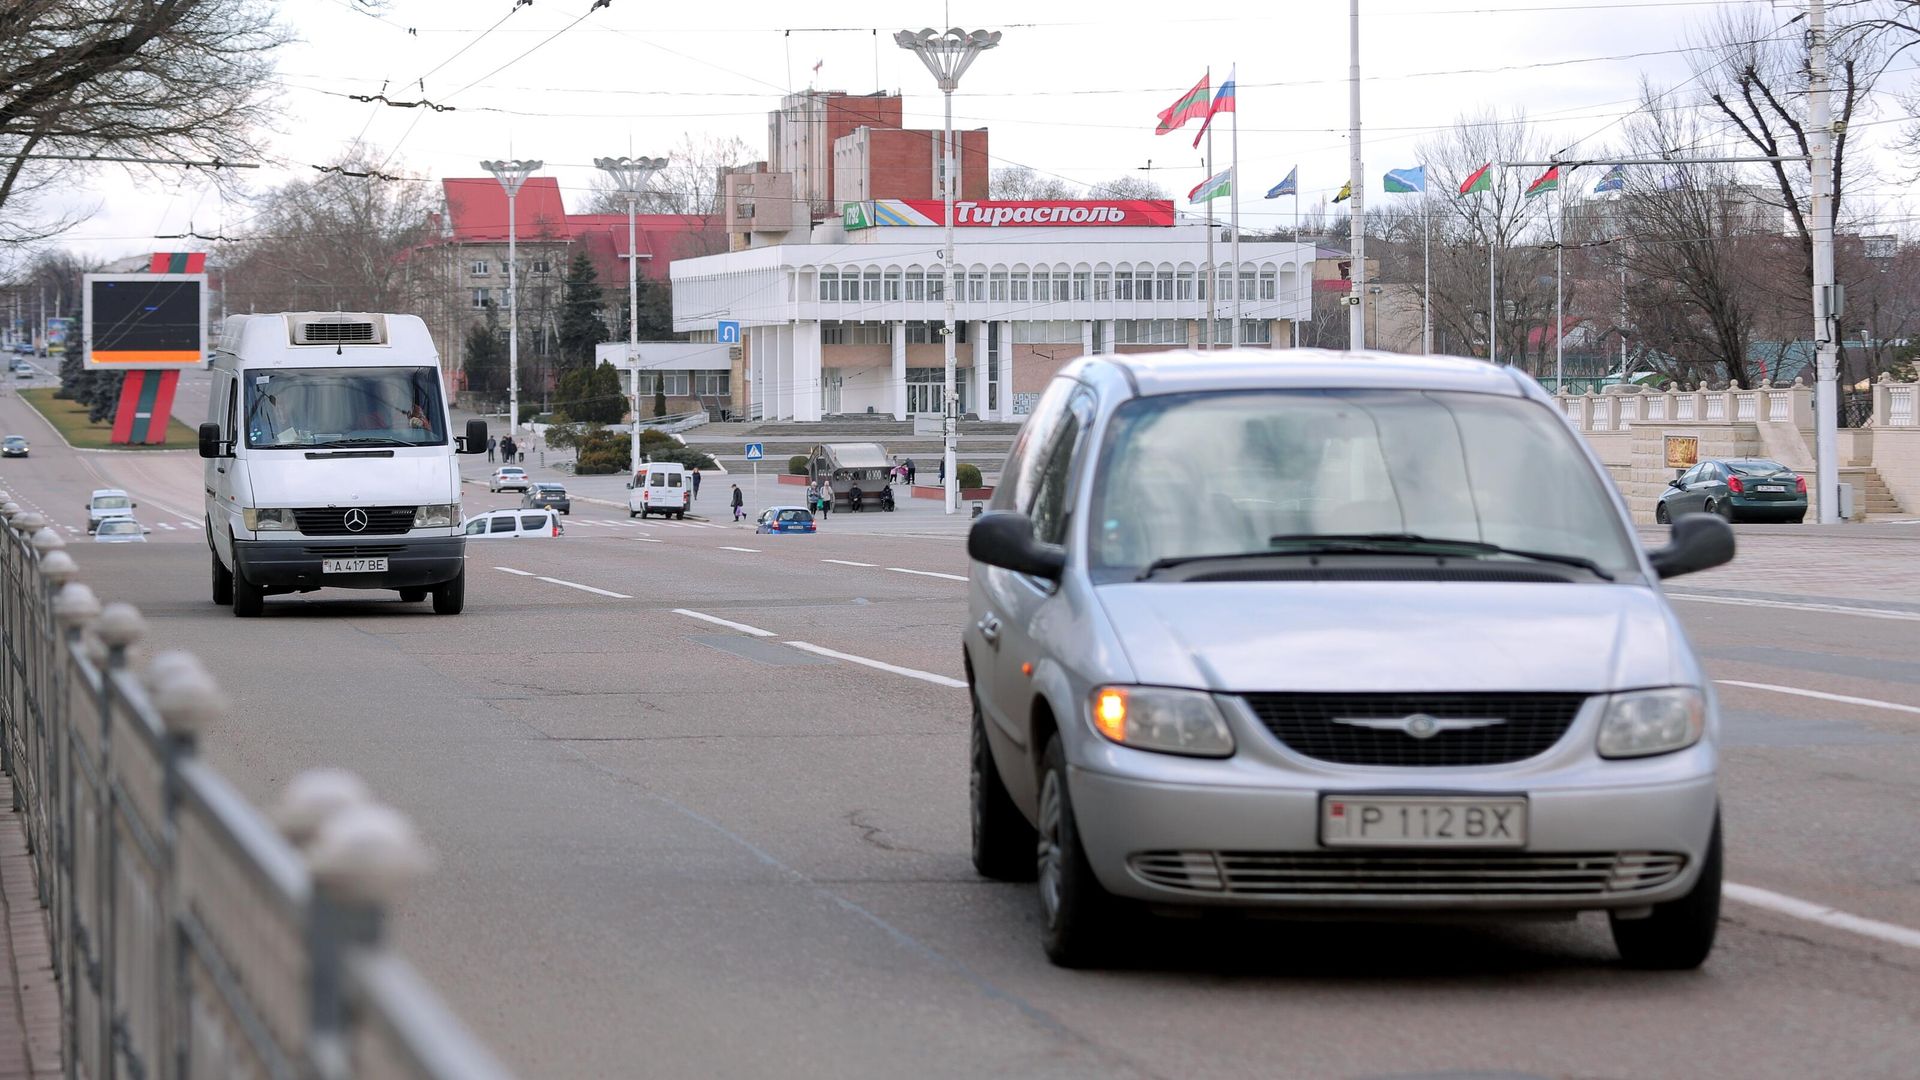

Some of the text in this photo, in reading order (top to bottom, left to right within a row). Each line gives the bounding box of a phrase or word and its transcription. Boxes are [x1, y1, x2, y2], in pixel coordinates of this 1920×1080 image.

[955, 201, 1125, 227] Тирасполь
[345, 560, 365, 571] 417
[1400, 807, 1455, 838] 112
